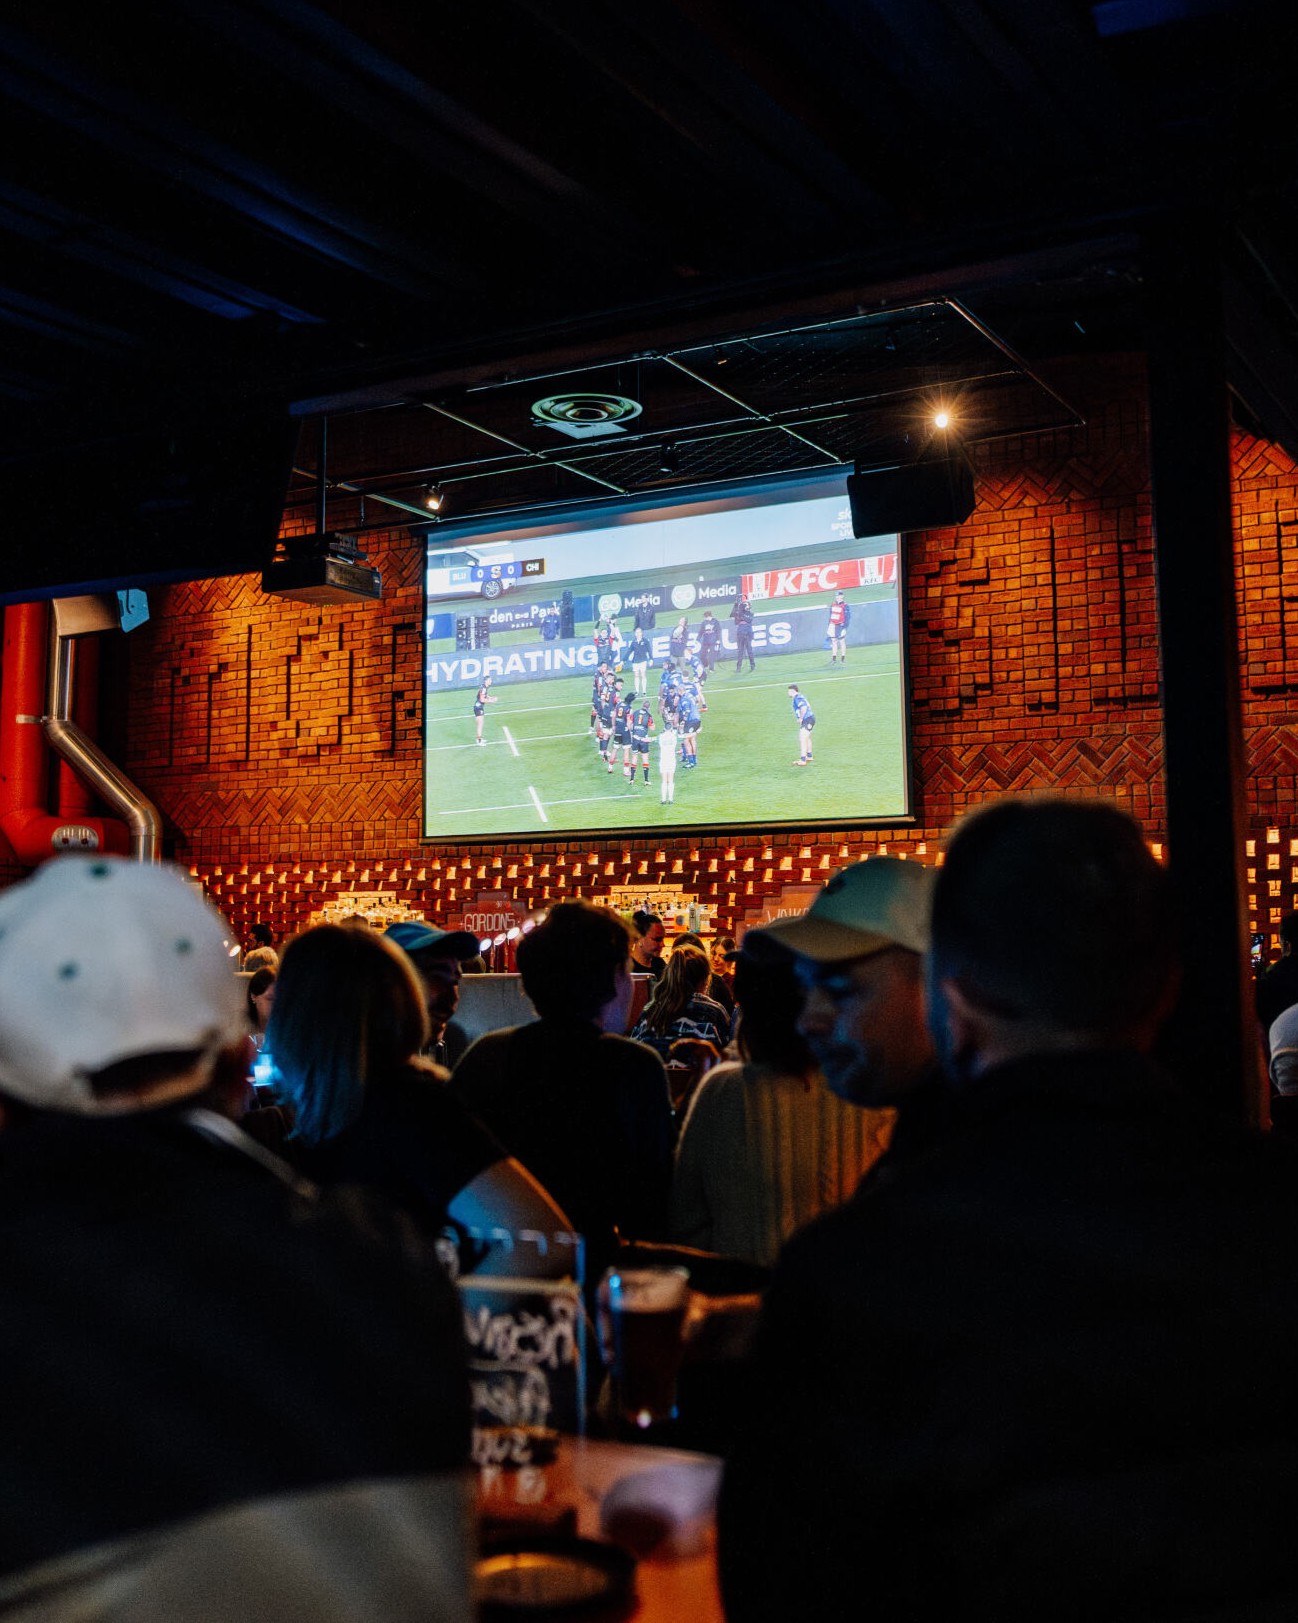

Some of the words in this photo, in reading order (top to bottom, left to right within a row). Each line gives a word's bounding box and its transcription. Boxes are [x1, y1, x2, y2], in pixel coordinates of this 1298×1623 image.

[525, 562, 540, 572] CHI
[774, 565, 840, 596] KFC
[698, 584, 737, 600] Media
[624, 593, 661, 609] Meia
[489, 609, 513, 624] den
[464, 912, 516, 932] GORDONS
